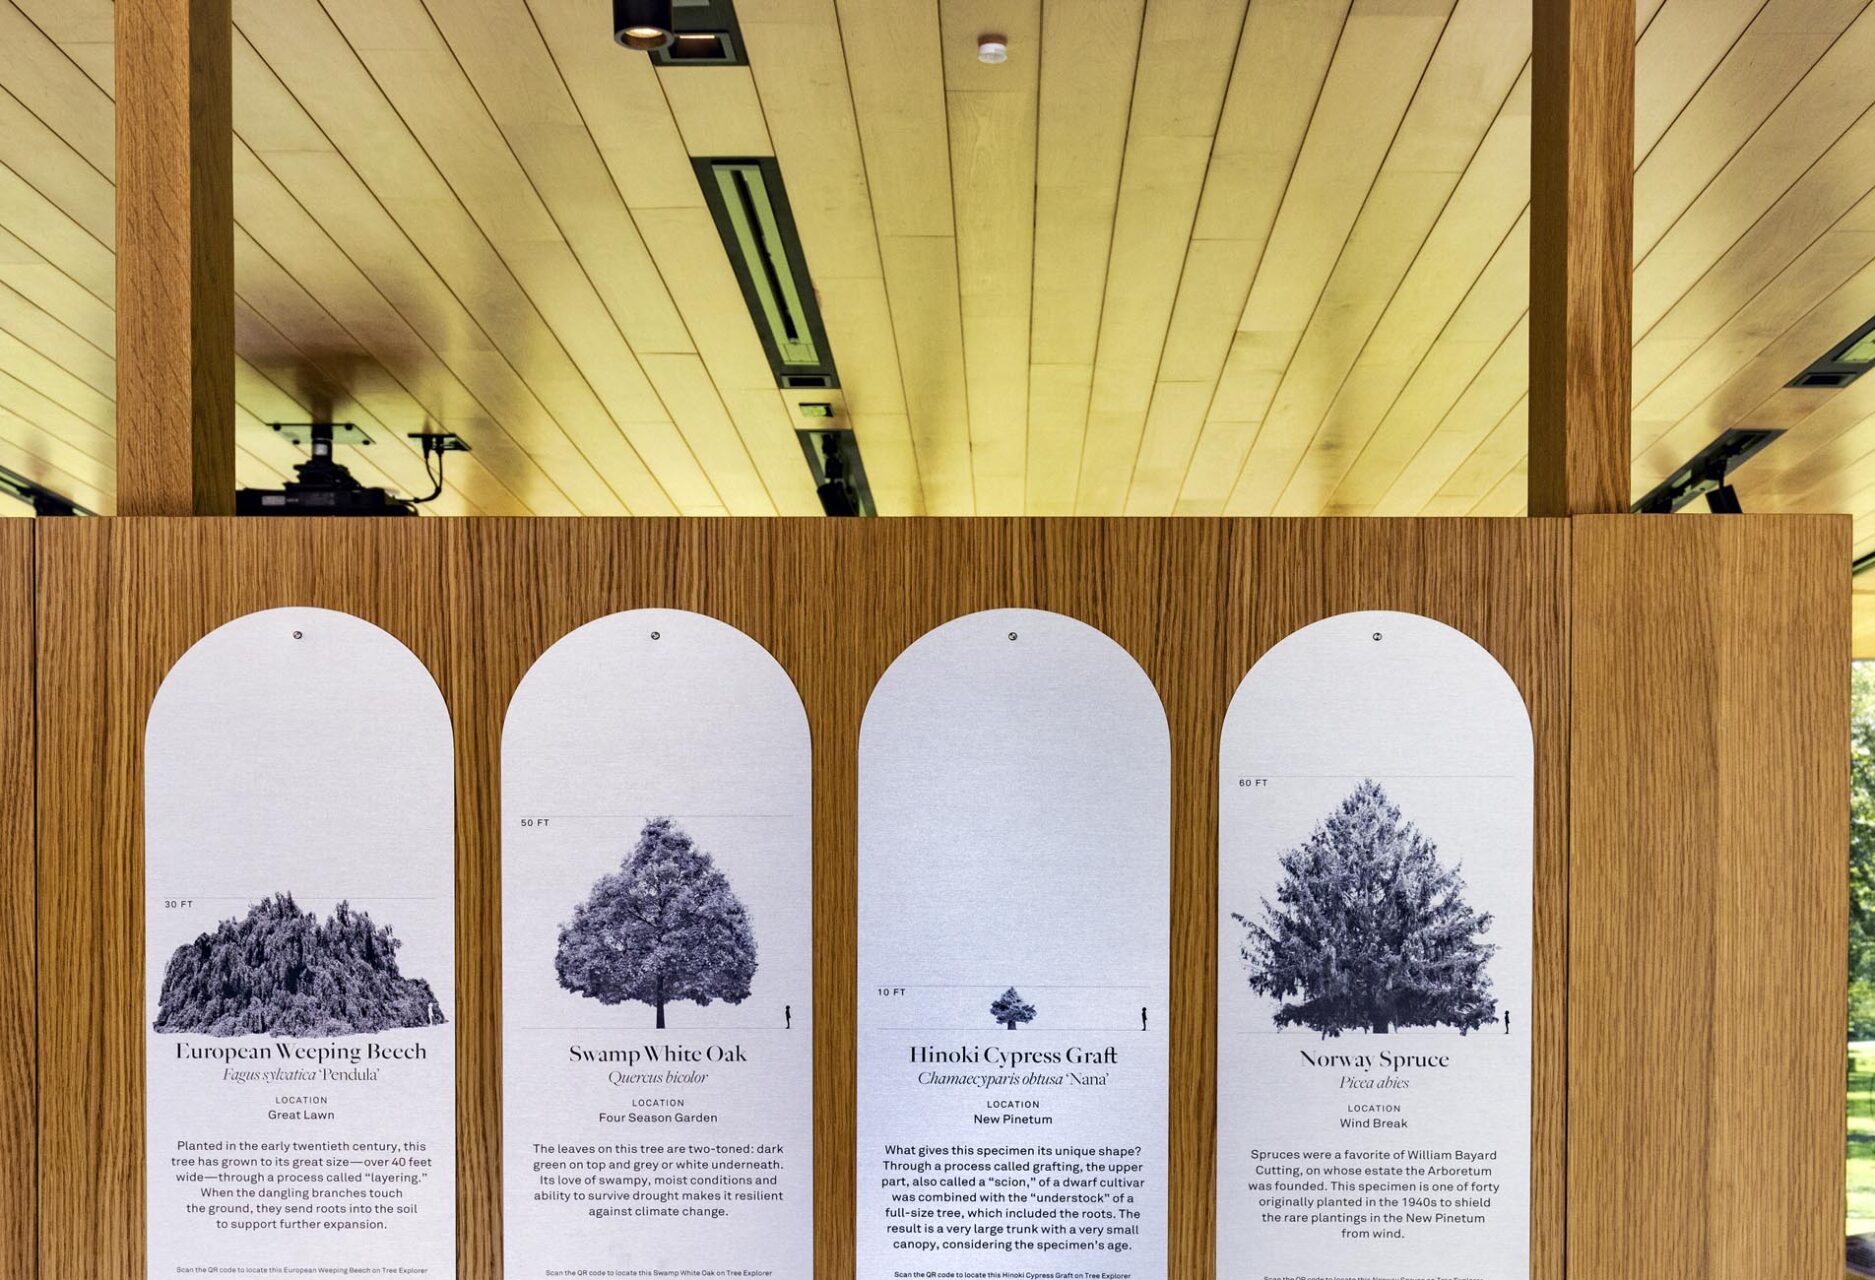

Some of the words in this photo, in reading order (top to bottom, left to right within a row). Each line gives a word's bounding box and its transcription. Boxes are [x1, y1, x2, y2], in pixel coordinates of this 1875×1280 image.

[1239, 779, 1252, 787] 60
[1255, 779, 1268, 787] FT
[521, 819, 533, 827] 50
[537, 819, 549, 827] FT
[164, 900, 177, 909] 30
[181, 900, 193, 908] FT
[878, 988, 890, 997] 10
[893, 988, 906, 996] FT
[176, 1043, 271, 1064] European
[276, 1042, 362, 1064] Weeping
[367, 1042, 427, 1059] Beech
[569, 1046, 641, 1066] Swamp
[643, 1045, 702, 1062] White
[706, 1045, 748, 1062] Oak
[909, 1046, 979, 1063] Hinoki
[984, 1047, 1061, 1068] Cypress
[1066, 1046, 1119, 1064] Graft
[1300, 1050, 1375, 1072] Norway
[1379, 1051, 1450, 1072] Spruce
[222, 1068, 260, 1084] Fagus
[262, 1067, 317, 1084] sylvatica
[608, 1071, 663, 1087] Quercus
[665, 1070, 709, 1084] bicolor
[918, 1071, 1020, 1089] Chamaecyparis
[1022, 1072, 1063, 1085] obtusa
[1339, 1076, 1375, 1089] Picea
[1376, 1075, 1410, 1089] abies
[275, 1096, 327, 1104] LOCATION
[632, 1099, 684, 1107] LOCATION
[987, 1100, 1039, 1109] LOCATION
[268, 1110, 301, 1120] Great
[304, 1110, 335, 1120] Lawn
[1348, 1104, 1401, 1113] LOCATION
[599, 1112, 626, 1123] Four
[628, 1112, 672, 1123] Season
[674, 1112, 718, 1123] Garden
[974, 1114, 1000, 1124] New
[1003, 1114, 1053, 1124] Pinetum
[1340, 1118, 1370, 1128] Wind
[1373, 1118, 1408, 1128] Break
[177, 1140, 223, 1151] Planted
[226, 1141, 236, 1150] in
[239, 1141, 258, 1151] the
[261, 1141, 291, 1153] early
[292, 1141, 350, 1151] twentieth
[352, 1142, 401, 1153] century,
[403, 1141, 426, 1151] this
[533, 1143, 555, 1154] The
[557, 1144, 596, 1154] leaves
[598, 1146, 612, 1154] on
[615, 1144, 638, 1154] this
[640, 1145, 664, 1154] tree
[666, 1146, 686, 1154] are
[688, 1144, 754, 1154] two-toned:
[756, 1144, 784, 1154] dark
[885, 1145, 916, 1155] What
[918, 1145, 949, 1158] gives
[951, 1145, 974, 1156] this
[976, 1145, 1035, 1158] specimen
[1037, 1145, 1053, 1156] its
[1055, 1146, 1096, 1158] unique
[1098, 1146, 1142, 1158] shape?
[171, 1157, 195, 1166] tree
[198, 1156, 219, 1167] has
[221, 1159, 258, 1169] grown
[260, 1158, 272, 1166] to
[275, 1156, 290, 1167] its
[292, 1158, 323, 1169] great
[391, 1157, 406, 1167] 40
[408, 1157, 432, 1167] feet
[1250, 1149, 1300, 1162] Spruces
[1302, 1152, 1332, 1160] were
[1334, 1152, 1342, 1160] a
[1344, 1149, 1391, 1160] favorite
[1393, 1150, 1406, 1160] of
[1407, 1149, 1452, 1160] William
[1455, 1150, 1497, 1163] Bayard
[533, 1161, 566, 1172] green
[569, 1161, 583, 1169] on
[586, 1161, 606, 1172] top
[608, 1160, 631, 1170] and
[633, 1161, 659, 1172] grey
[661, 1162, 674, 1170] or
[676, 1159, 709, 1170] white
[711, 1159, 784, 1170] underneath.
[882, 1160, 932, 1173] Through
[934, 1163, 942, 1171] a
[944, 1163, 991, 1173] process
[993, 1161, 1030, 1171] called
[1033, 1161, 1083, 1174] grafting,
[1086, 1162, 1106, 1172] the
[1108, 1164, 1143, 1174] upper
[1255, 1165, 1303, 1178] Cutting,
[1306, 1167, 1320, 1175] on
[1323, 1165, 1362, 1176] whose
[1364, 1167, 1403, 1176] estate
[1405, 1166, 1425, 1176] the
[1427, 1166, 1492, 1176] Arboretum
[267, 1174, 274, 1182] a
[277, 1174, 324, 1184] process
[326, 1172, 362, 1183] called
[881, 1177, 909, 1189] part,
[912, 1176, 937, 1187] also
[939, 1176, 976, 1187] called
[978, 1179, 986, 1187] a
[1038, 1177, 1051, 1187] of
[1053, 1179, 1060, 1187] a
[1062, 1177, 1097, 1187] dwarf
[1099, 1177, 1145, 1188] cultivar
[1248, 1183, 1272, 1191] was
[1274, 1180, 1328, 1191] founded.
[1330, 1181, 1356, 1191] This
[1358, 1181, 1416, 1194] specimen
[1419, 1181, 1429, 1192] is
[1432, 1184, 1454, 1192] one
[1456, 1181, 1469, 1192] of
[1471, 1181, 1500, 1194] forty
[1341, 1228, 1370, 1239] from
[1372, 1228, 1405, 1239] wind.
[1025, 1272, 1054, 1280] Cypress
[1101, 1272, 1131, 1280] Explorer
